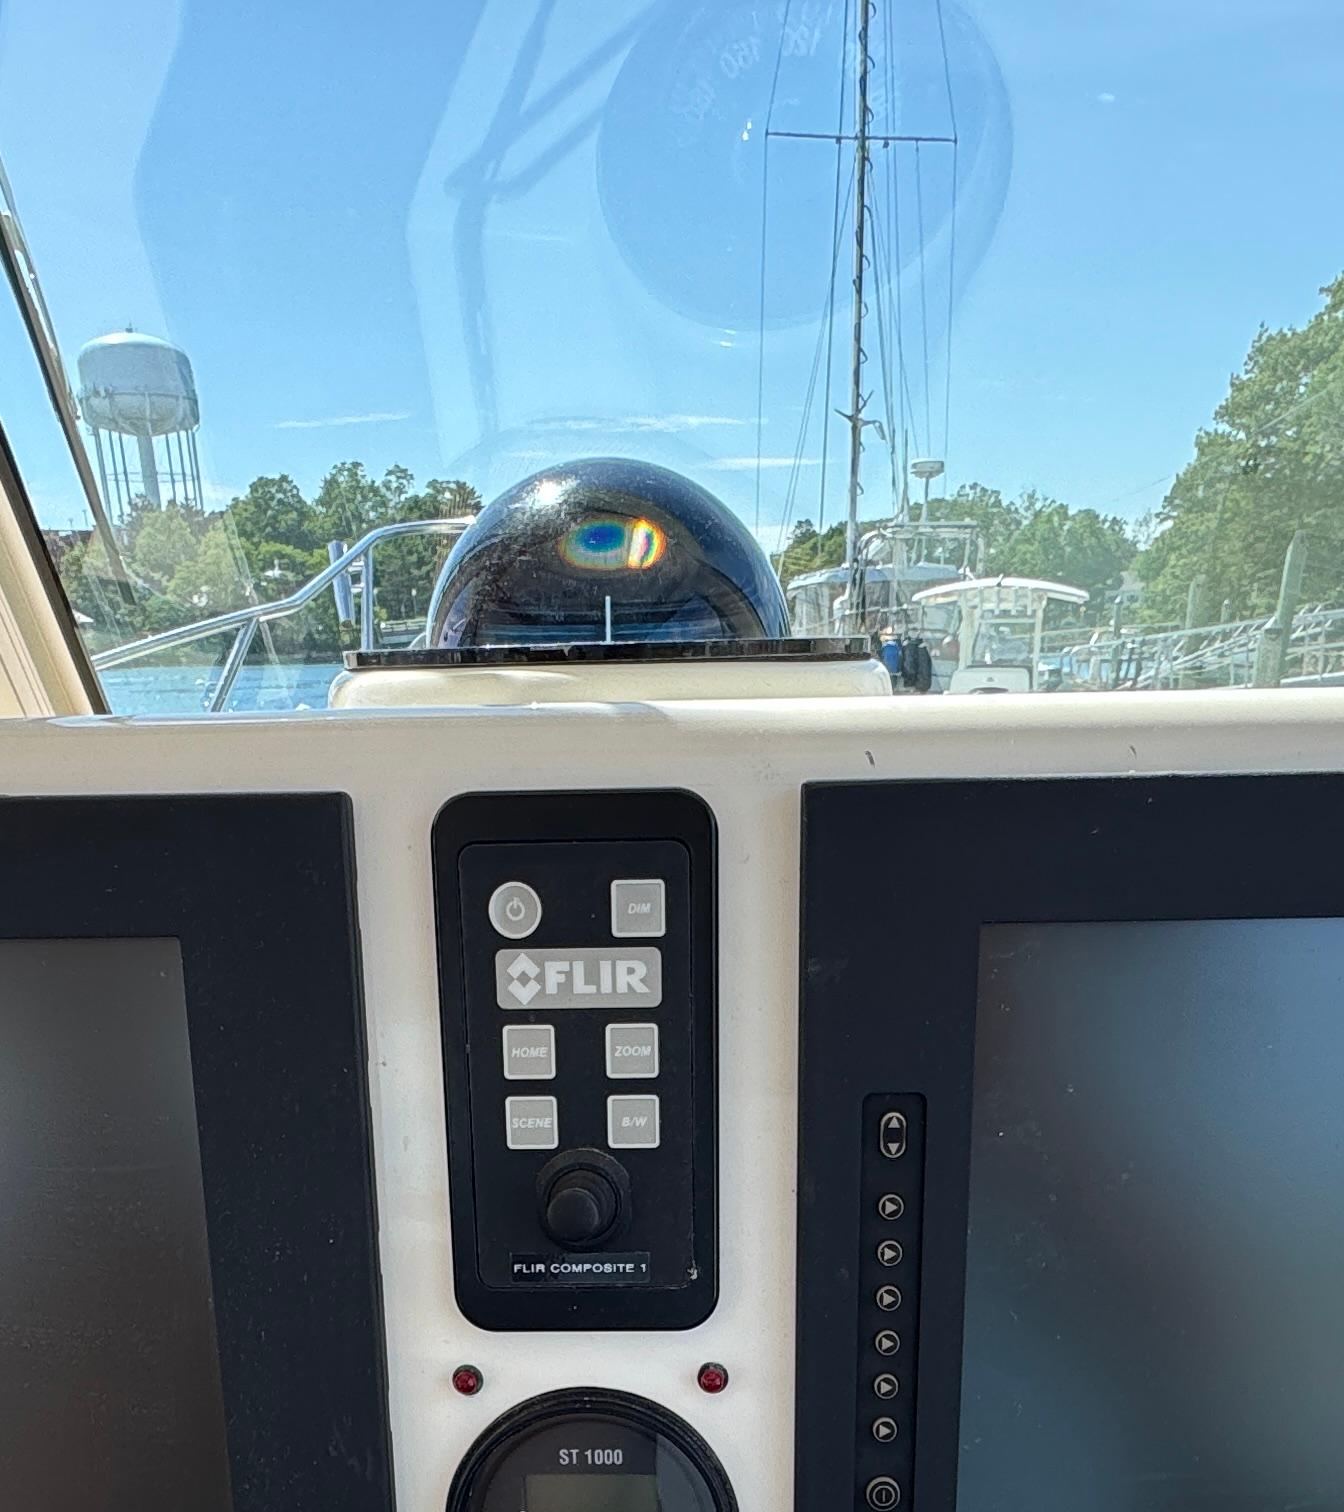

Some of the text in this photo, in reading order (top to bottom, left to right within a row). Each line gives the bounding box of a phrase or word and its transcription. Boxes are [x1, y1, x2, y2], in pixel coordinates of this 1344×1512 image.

[628, 902, 650, 915] DIM
[544, 961, 651, 994] FLIR
[511, 1047, 547, 1057] HOME
[615, 1046, 650, 1057] ZOOM
[511, 1117, 551, 1129] SCENE
[621, 1117, 647, 1128] B/W
[513, 1263, 636, 1273] FLIR COMPOSITE
[559, 1449, 623, 1465] ST 1000
